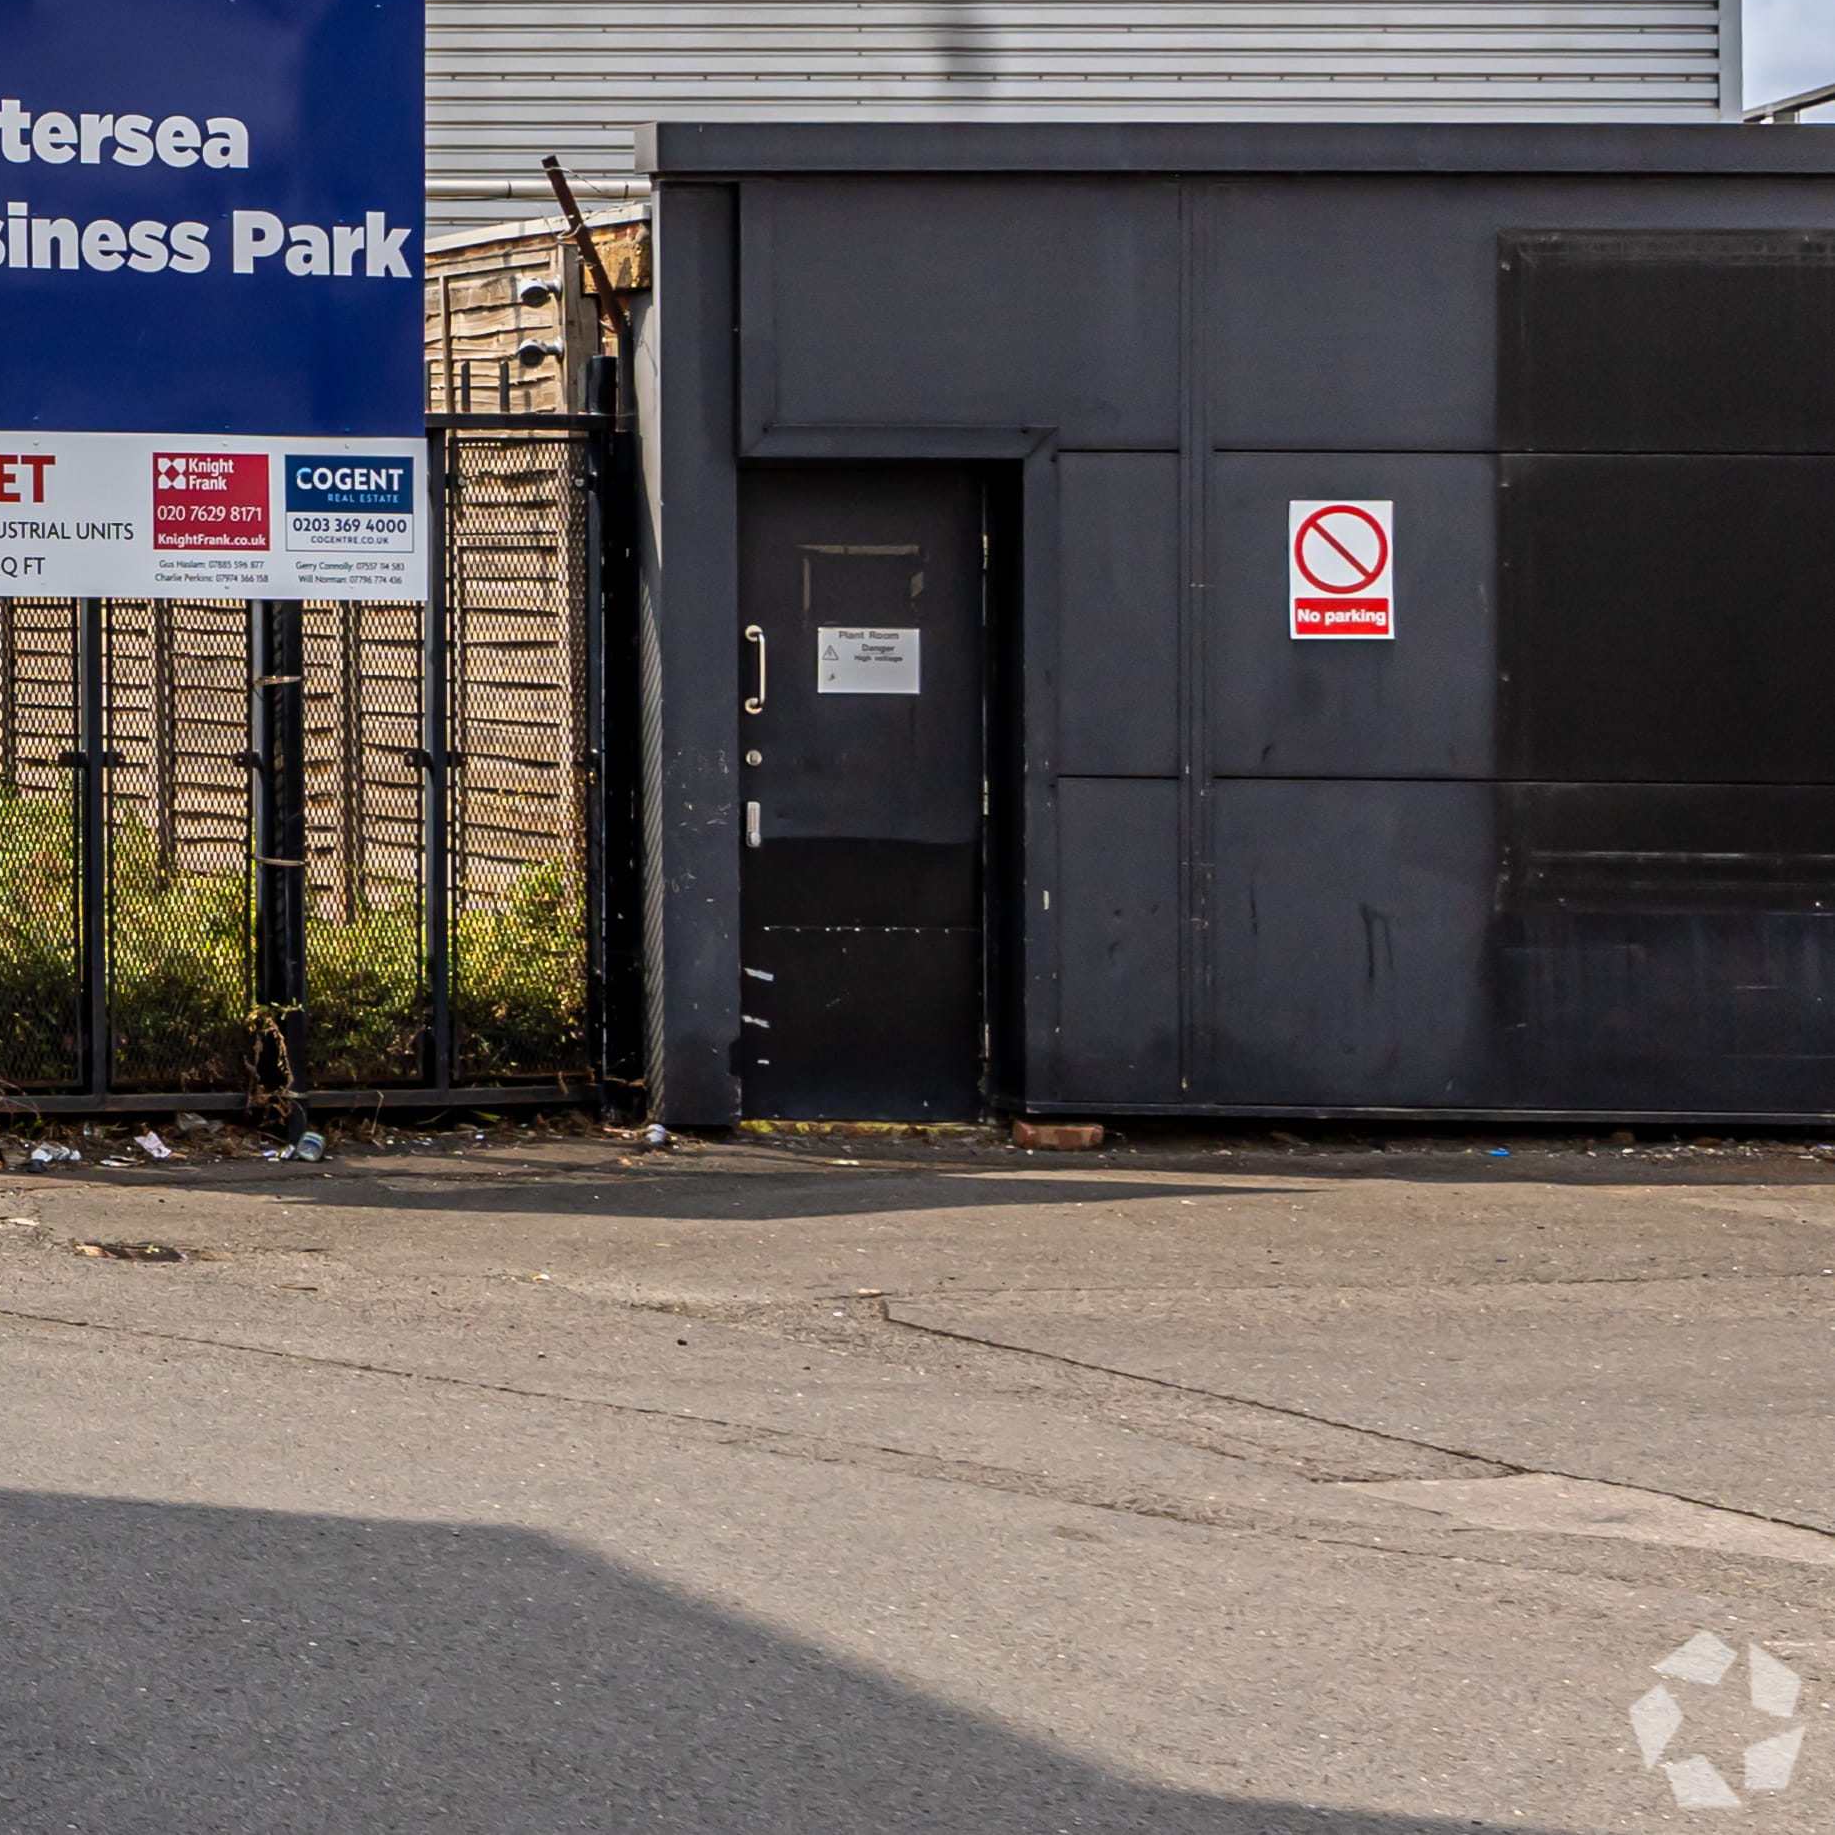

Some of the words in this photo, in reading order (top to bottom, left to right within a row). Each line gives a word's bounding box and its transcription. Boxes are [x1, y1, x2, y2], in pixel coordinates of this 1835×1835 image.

[233, 210, 412, 278] Park
[189, 457, 234, 477] Knight
[189, 475, 228, 490] Frank
[296, 467, 404, 492] COGENT
[327, 493, 355, 503] REAL
[359, 494, 399, 503] ESTATE
[157, 505, 186, 521] 020
[190, 505, 226, 522] 7629
[230, 505, 262, 522] 8171
[76, 522, 134, 540] UNITS
[293, 517, 330, 532] 0203
[334, 518, 361, 533] 369
[365, 518, 407, 533] 4000
[158, 532, 266, 548] KnightFrank.co.uk
[310, 535, 389, 545] COGENTRE.CO.UK
[24, 557, 46, 575] FT
[1297, 608, 1321, 622] No
[1325, 608, 1387, 626] parking
[839, 630, 864, 639] Plant
[869, 630, 899, 640] Room
[862, 644, 895, 654] Danger
